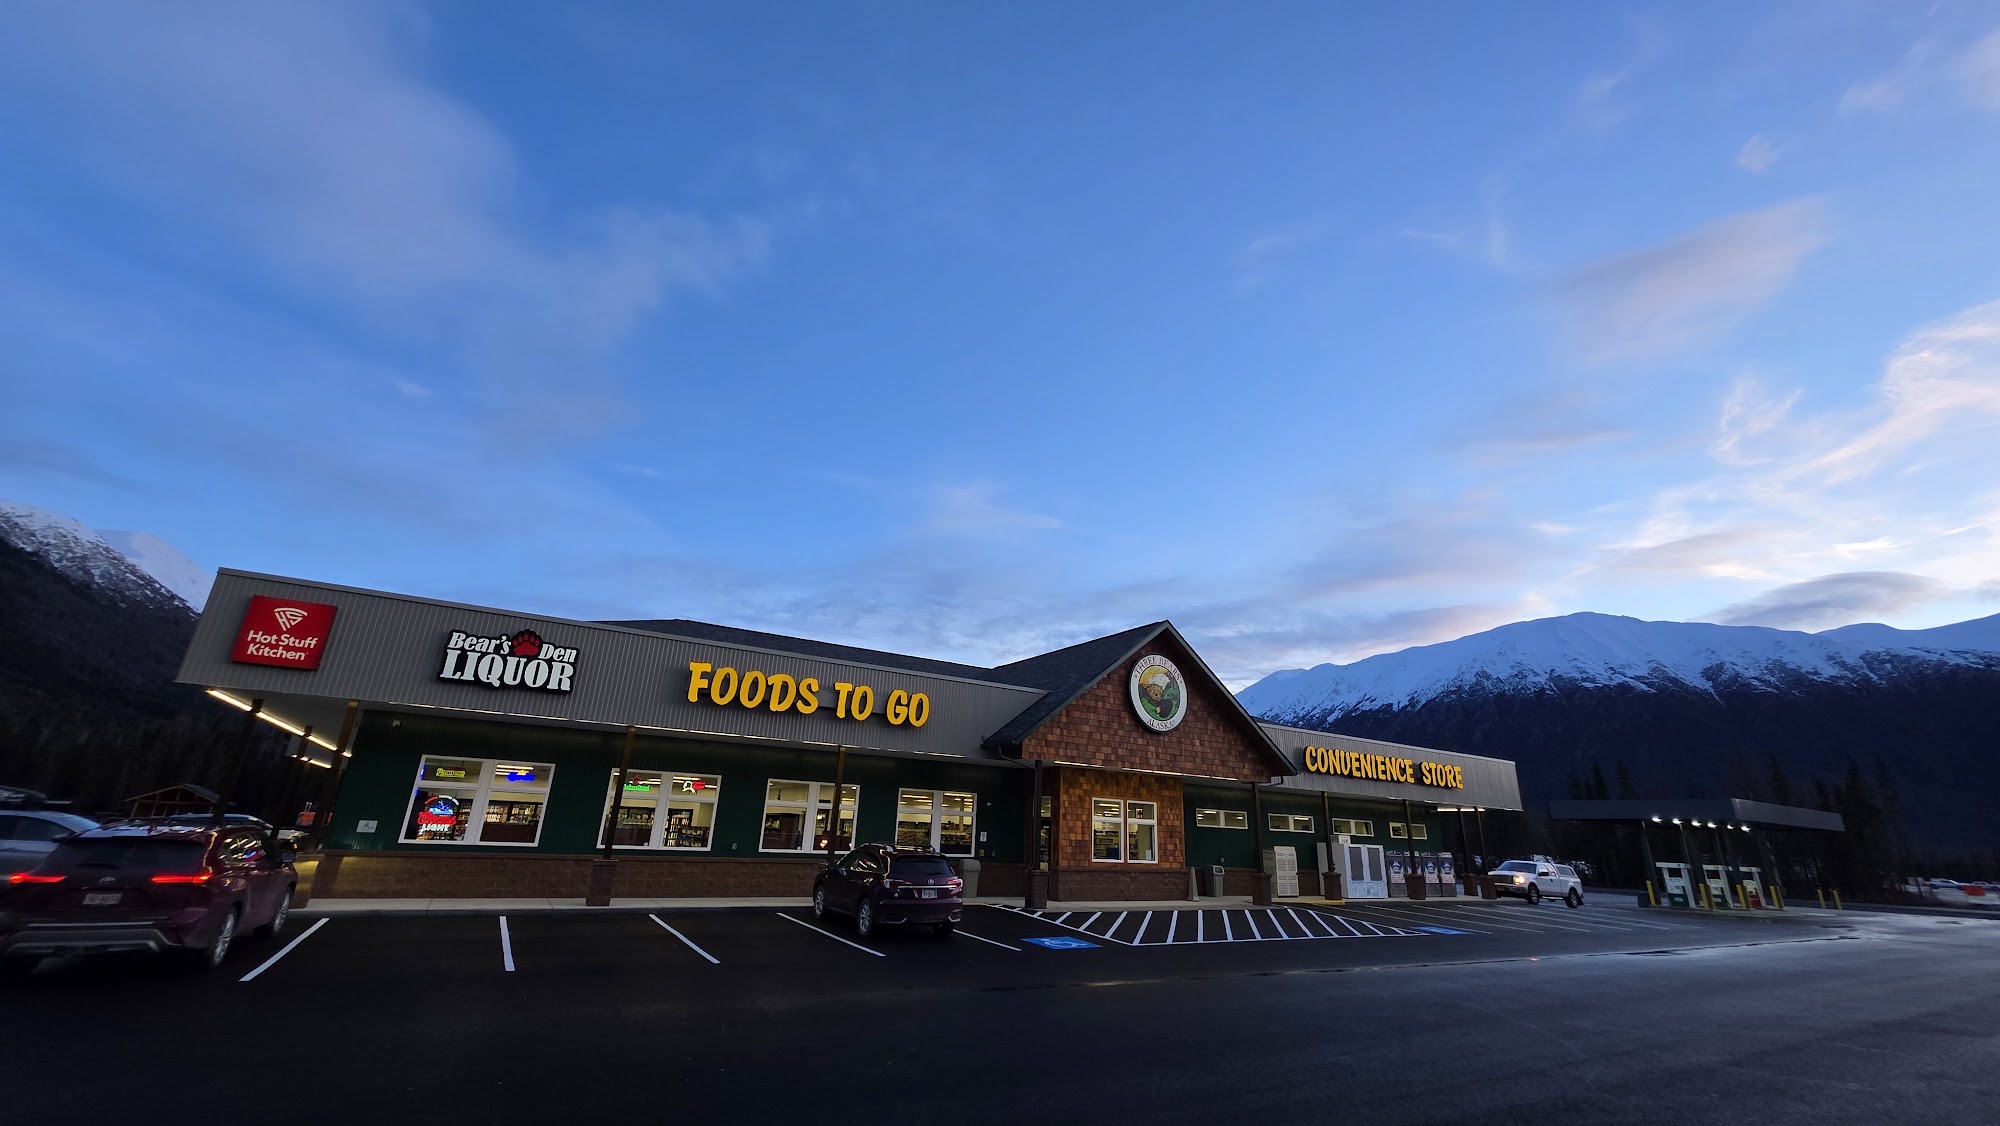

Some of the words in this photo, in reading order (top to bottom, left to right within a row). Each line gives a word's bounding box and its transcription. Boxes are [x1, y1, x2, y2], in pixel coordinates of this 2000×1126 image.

[247, 630, 278, 644] Hot
[279, 634, 318, 649] Stuff
[247, 643, 306, 661] Kitchen
[447, 632, 512, 655] Bear's
[538, 643, 577, 663] Den
[440, 649, 574, 691] LIQUOR
[1135, 656, 1158, 674] THREE
[1159, 657, 1182, 681] BEARS
[687, 661, 820, 715] FOODS
[835, 682, 874, 721] TO
[886, 689, 930, 728] GO
[1147, 718, 1174, 730] ALASKA
[1305, 745, 1415, 783] CONVENIENCE
[1420, 761, 1464, 789] STORE
